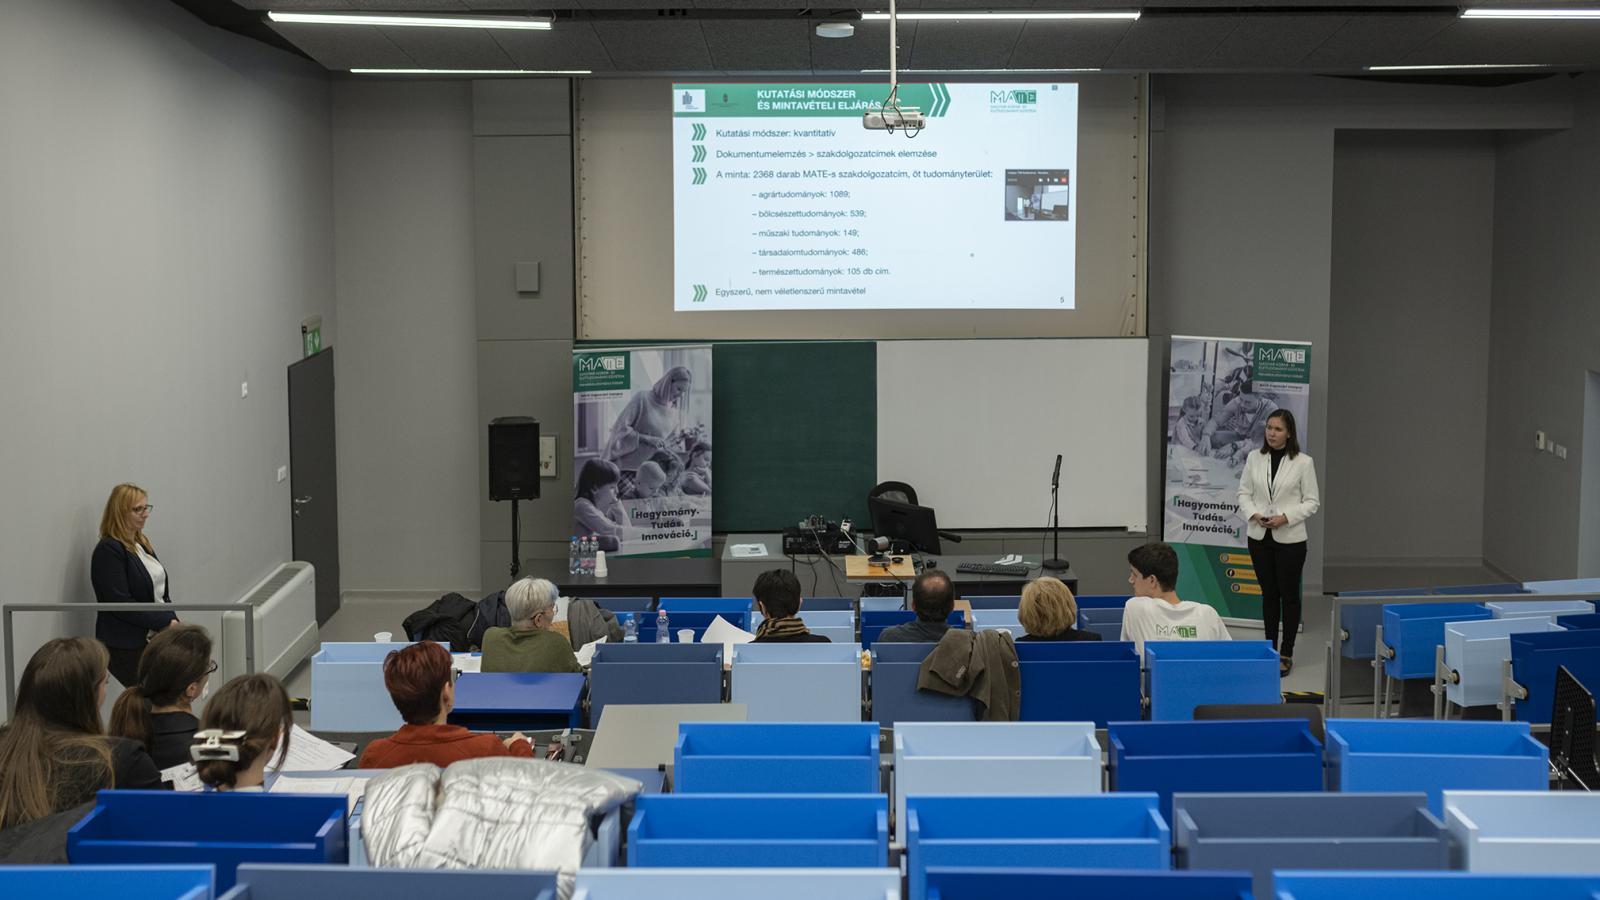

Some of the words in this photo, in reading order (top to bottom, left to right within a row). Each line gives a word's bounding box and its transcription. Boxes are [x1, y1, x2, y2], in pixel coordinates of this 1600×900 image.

[757, 88, 804, 98] KUTATÁSI
[808, 88, 856, 98] MÓDSZER
[990, 90, 1037, 104] MATE
[757, 99, 771, 110] ÉS
[773, 99, 835, 110] MINTAVÉTELI
[838, 99, 882, 110] ELJÁRÁS
[716, 129, 750, 138] Kutatási
[753, 129, 791, 138] módszer:
[794, 129, 836, 138] kvantitatív
[716, 149, 806, 159] Dokumentumelemzés
[816, 149, 896, 160] szakdolgozatcímek
[898, 149, 937, 158] elemzése
[726, 170, 750, 178] minta:
[753, 170, 774, 178] 2368
[776, 170, 800, 178] darab
[803, 169, 836, 178] MATE-s
[838, 169, 910, 181] szakdolgozatcím,
[912, 170, 921, 178] öt
[923, 169, 992, 180] tudományterület:
[759, 190, 828, 200] agrártudományok:
[830, 190, 850, 199] 1089;
[758, 209, 848, 219] bölcsészettudományok:
[850, 209, 866, 218] 539;
[758, 228, 790, 237] műszaki
[792, 228, 841, 238] tudományok:
[843, 228, 860, 238] 149;
[758, 247, 849, 258] társadalomtudományok:
[758, 267, 845, 277] természettudományok:
[847, 267, 861, 276] 105
[863, 267, 873, 276] db
[875, 267, 891, 276] cím.
[715, 287, 753, 297] Egyszerű,
[774, 286, 824, 296] véletlenszerű
[827, 286, 867, 296] mintavétel
[1259, 348, 1305, 364] MATE
[579, 356, 625, 371] MATE
[1177, 500, 1242, 514] Hagyomány.
[636, 508, 700, 520] Hagyomány.
[1193, 512, 1227, 522] Tudás.
[651, 519, 684, 529] Tudás.
[1183, 523, 1236, 534] Innováció.
[641, 529, 693, 541] Innováció.
[1156, 624, 1197, 638] MATE
